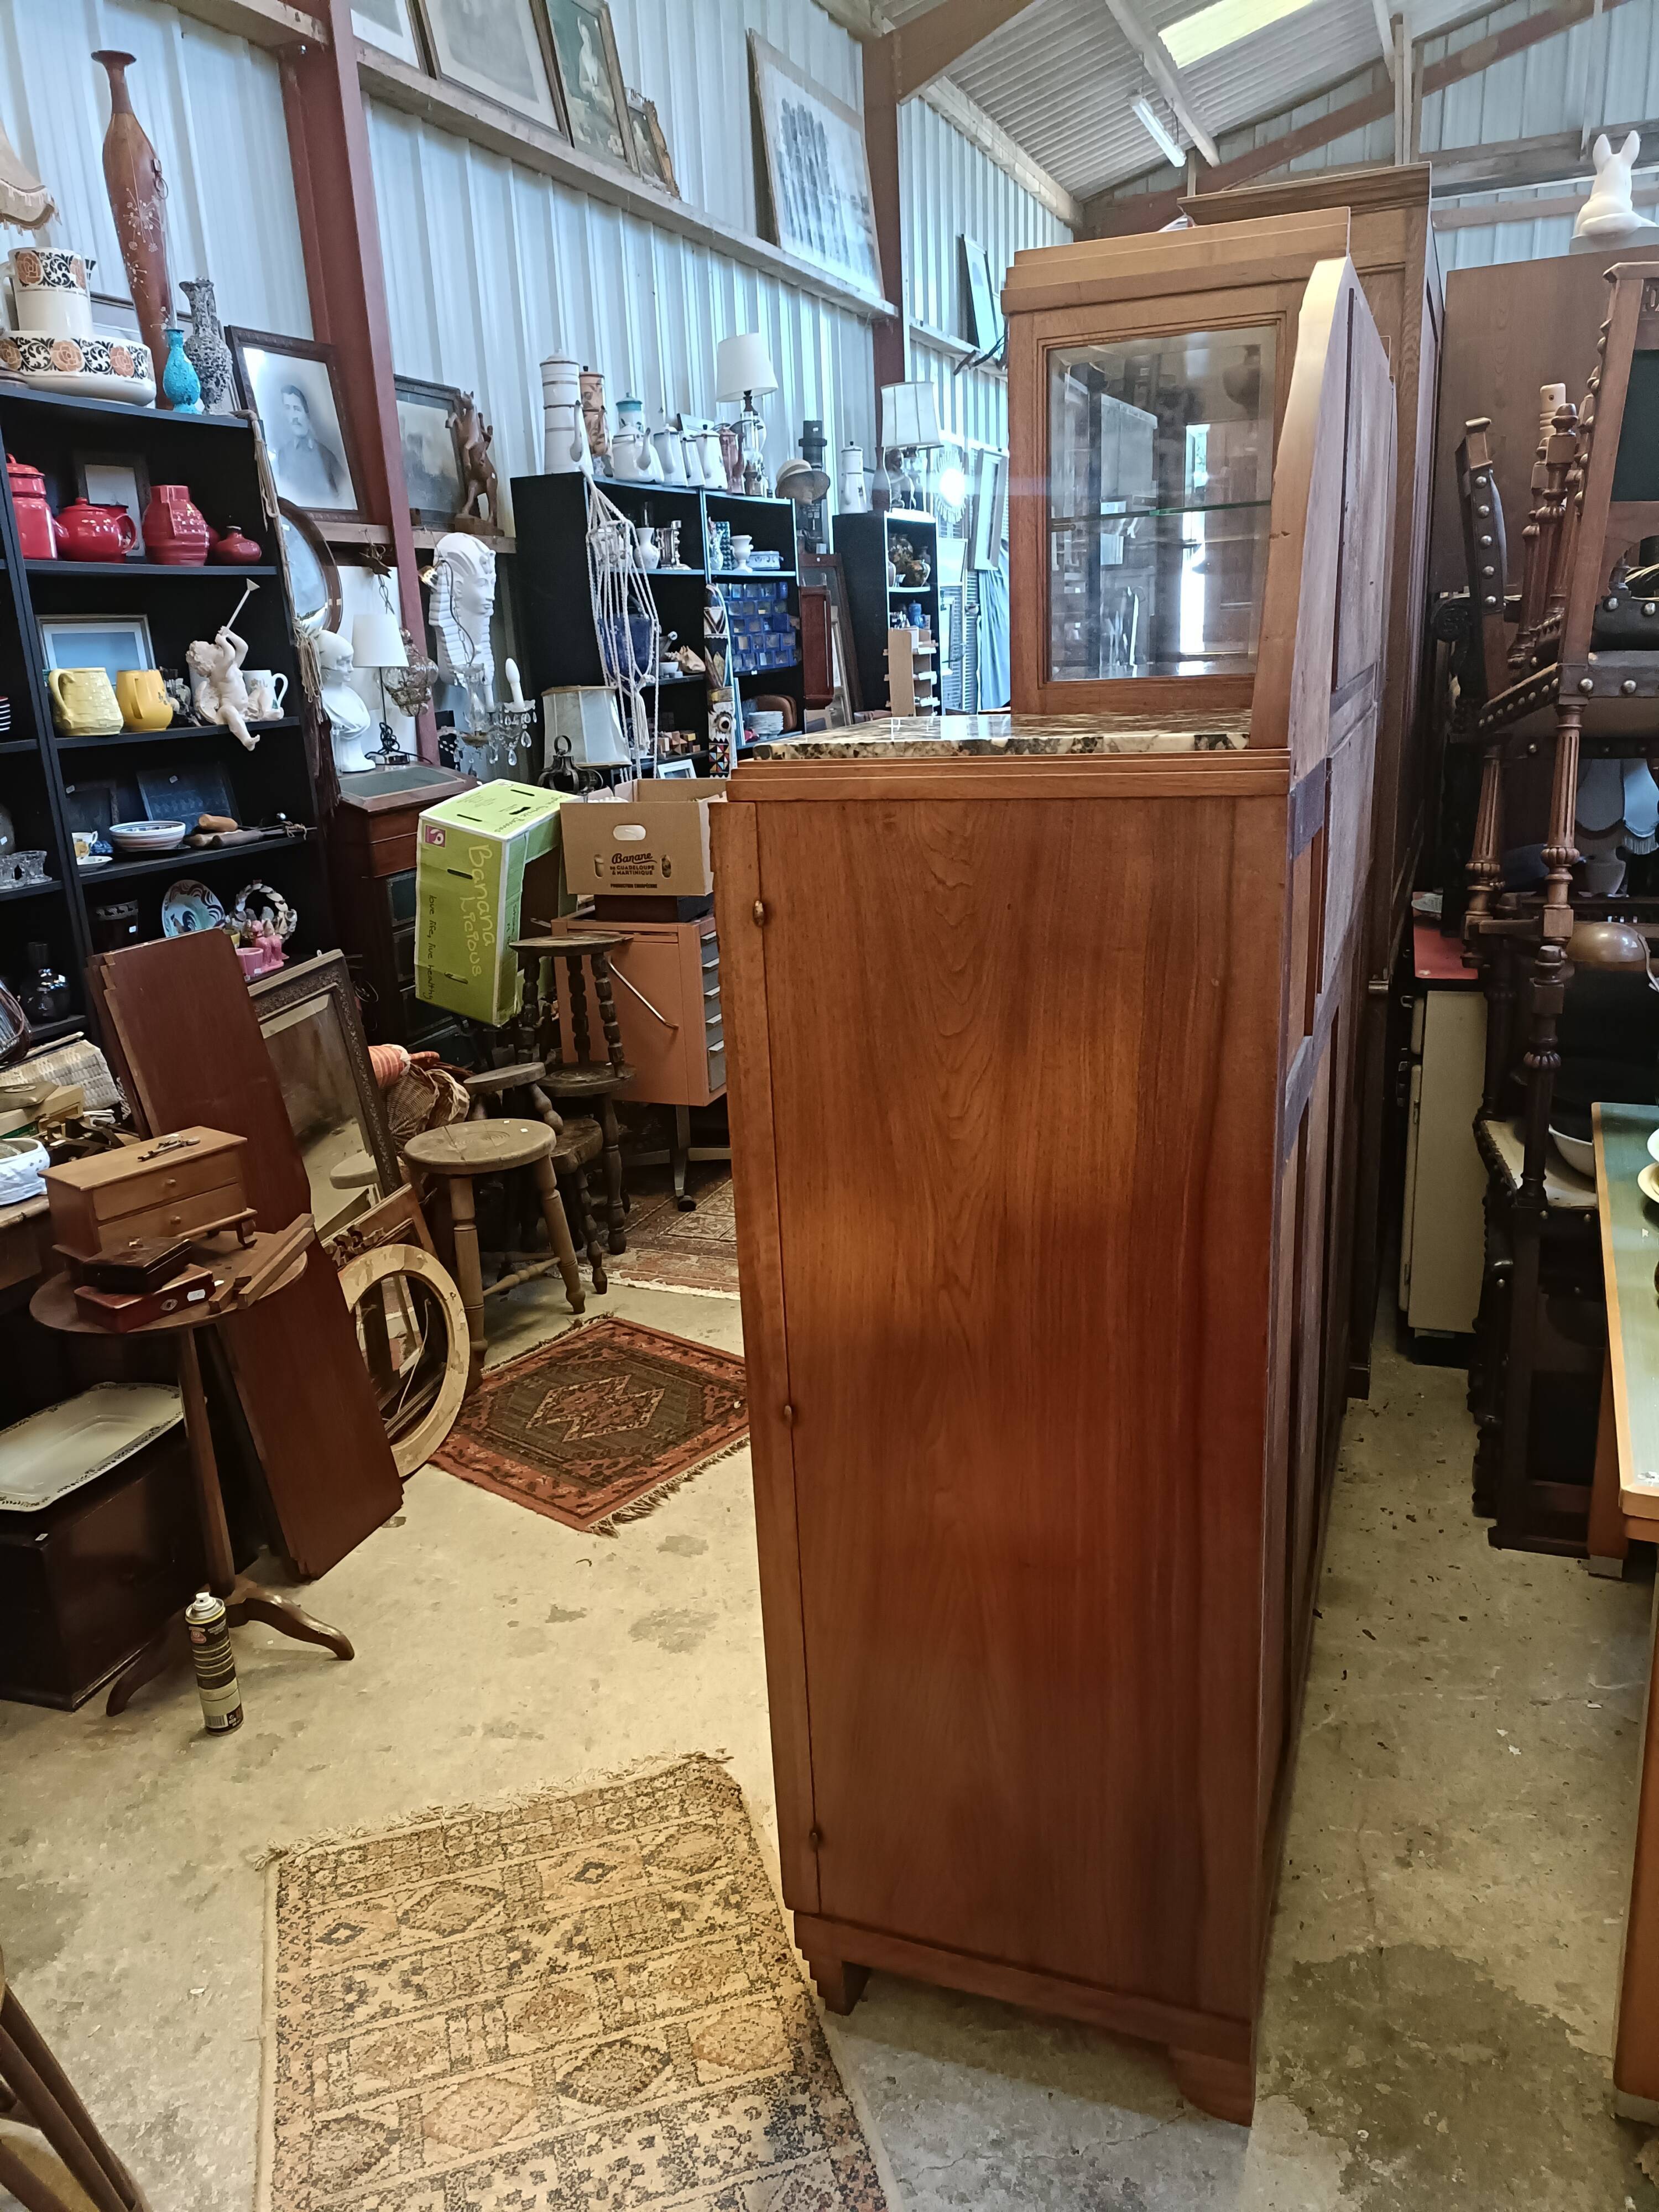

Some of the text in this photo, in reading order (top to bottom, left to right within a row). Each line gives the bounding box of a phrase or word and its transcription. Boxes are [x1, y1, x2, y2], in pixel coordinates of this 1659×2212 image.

[468, 844, 495, 946] Banana
[611, 853, 658, 864] Banane
[422, 895, 437, 1000] love life, live healthy
